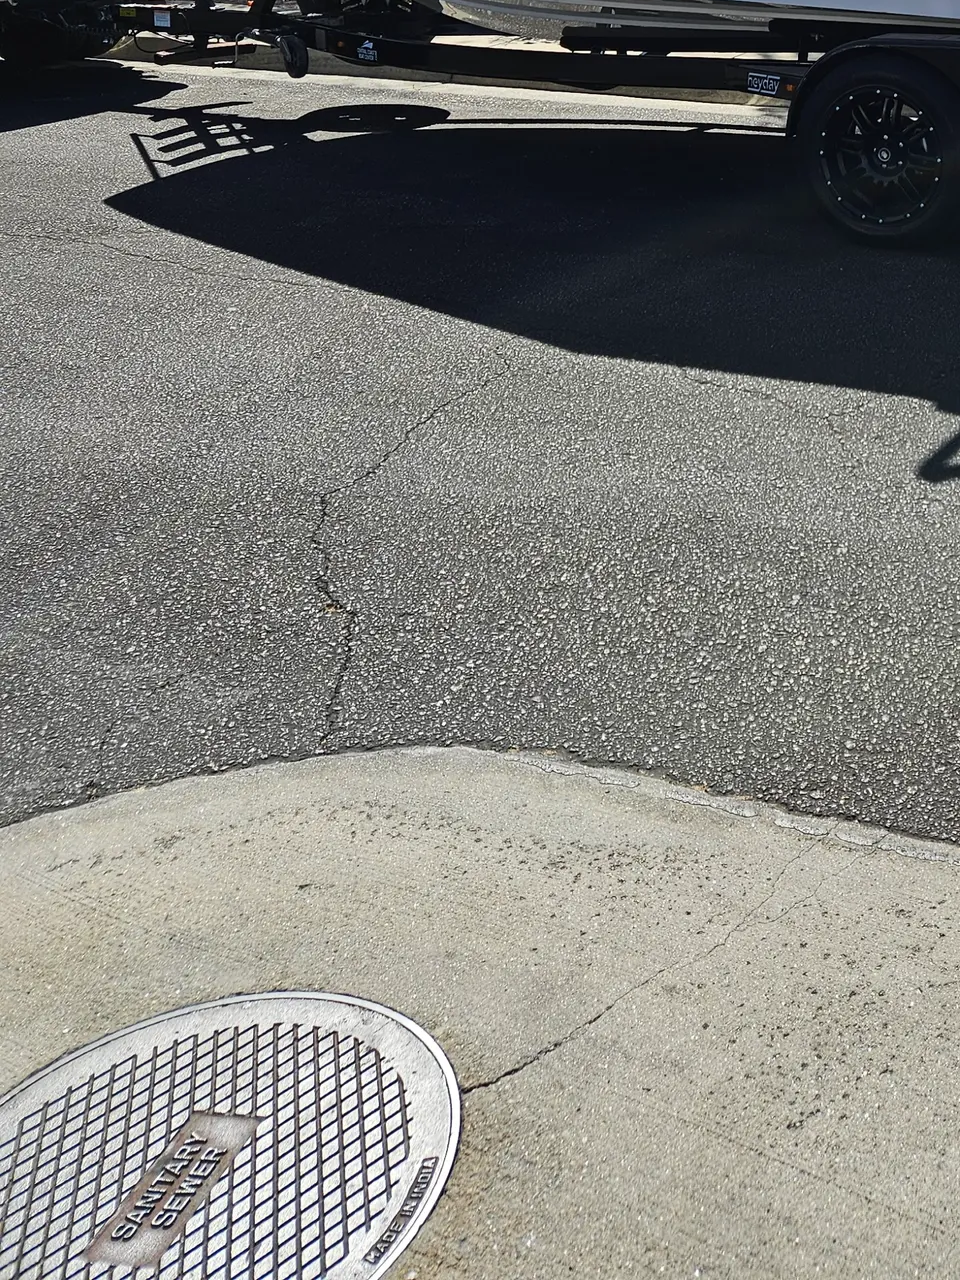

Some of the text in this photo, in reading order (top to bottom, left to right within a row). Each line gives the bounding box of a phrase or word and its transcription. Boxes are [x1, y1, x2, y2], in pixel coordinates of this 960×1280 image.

[111, 1132, 208, 1241] SANITARY
[151, 1147, 228, 1230] SEWER
[364, 1158, 437, 1264] MADE IN INDIA
